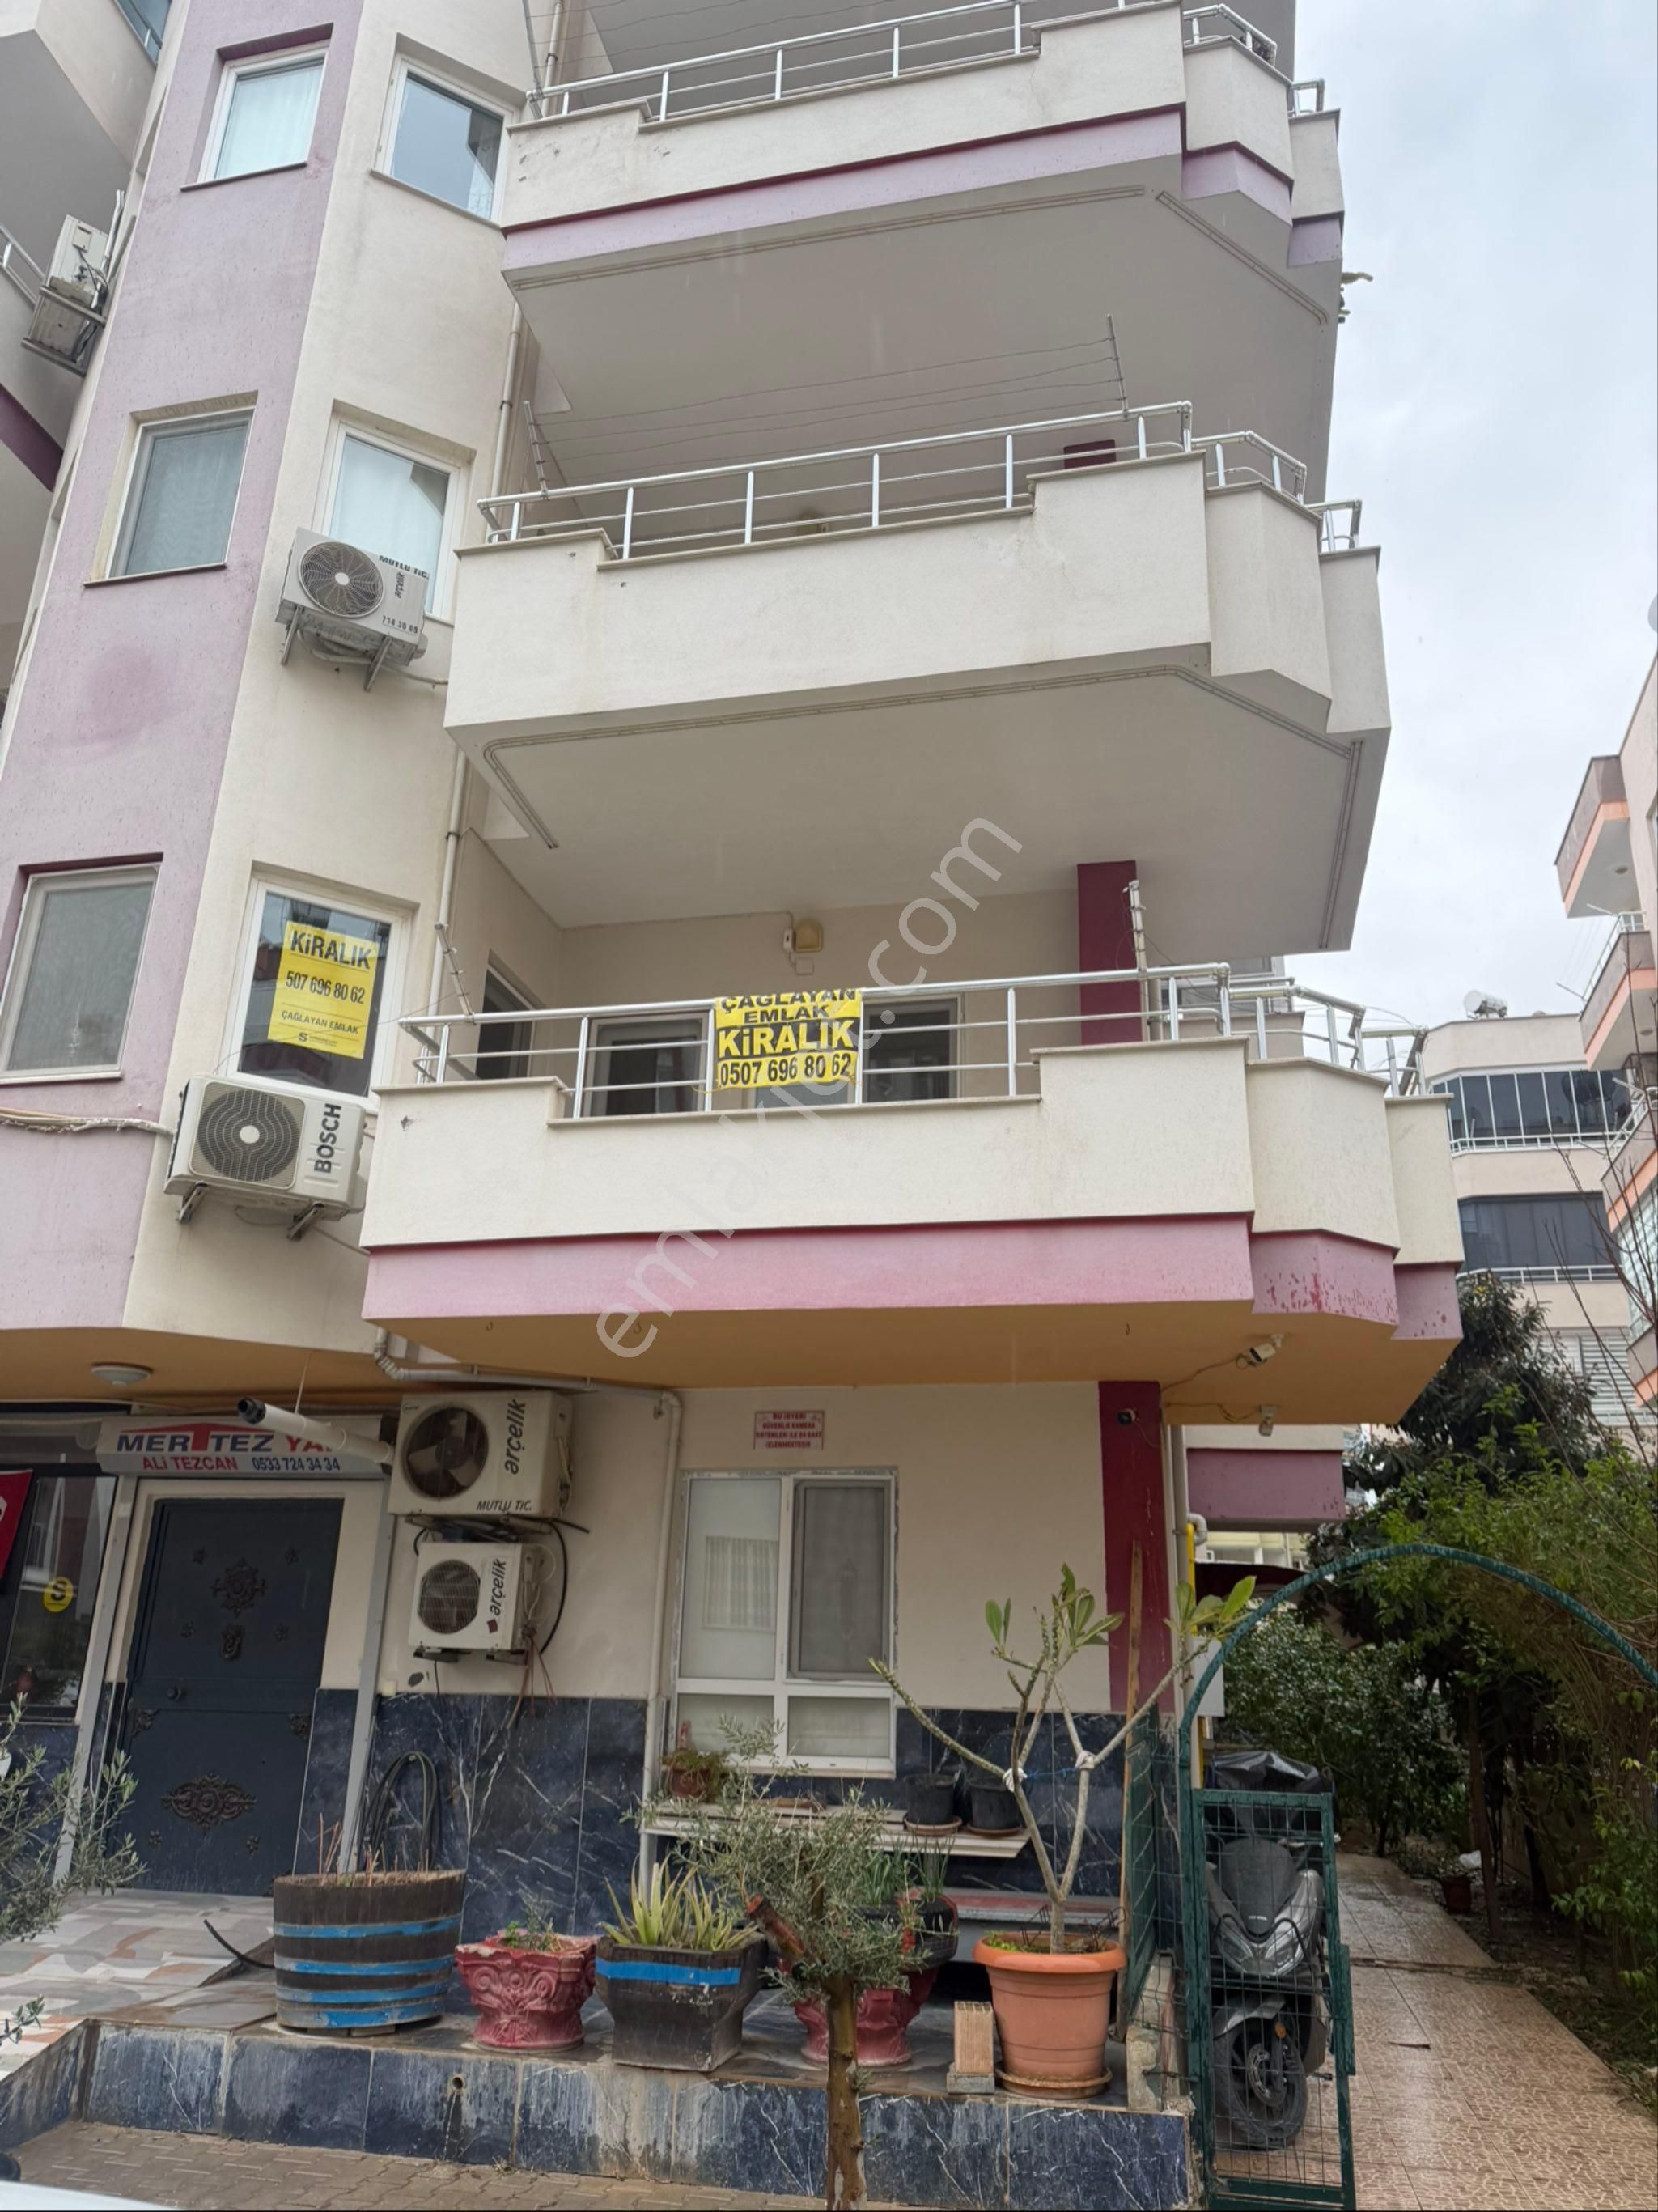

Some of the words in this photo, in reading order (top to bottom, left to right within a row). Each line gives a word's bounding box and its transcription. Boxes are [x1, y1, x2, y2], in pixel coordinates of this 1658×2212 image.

[380, 555, 410, 571] MUTLU
[286, 971, 307, 991] 507
[310, 977, 331, 996] 696
[334, 983, 348, 1000] 80
[351, 987, 365, 1004] 62
[744, 1004, 829, 1023] EMLAK
[329, 1021, 358, 1034] EMLAK
[720, 1060, 762, 1085] 0507
[768, 1057, 797, 1081] 696
[804, 1055, 825, 1077] 80
[832, 1053, 851, 1076] 62
[314, 1103, 341, 1173] BOSCH
[505, 1399, 526, 1475] arçelik
[170, 1456, 239, 1471] TEZCAN
[252, 1457, 281, 1471] 0533
[282, 1457, 304, 1471] 724
[307, 1457, 322, 1471] 34
[324, 1457, 340, 1471] 34
[476, 1500, 511, 1511] MUTLU
[490, 1559, 506, 1615] arçelik
